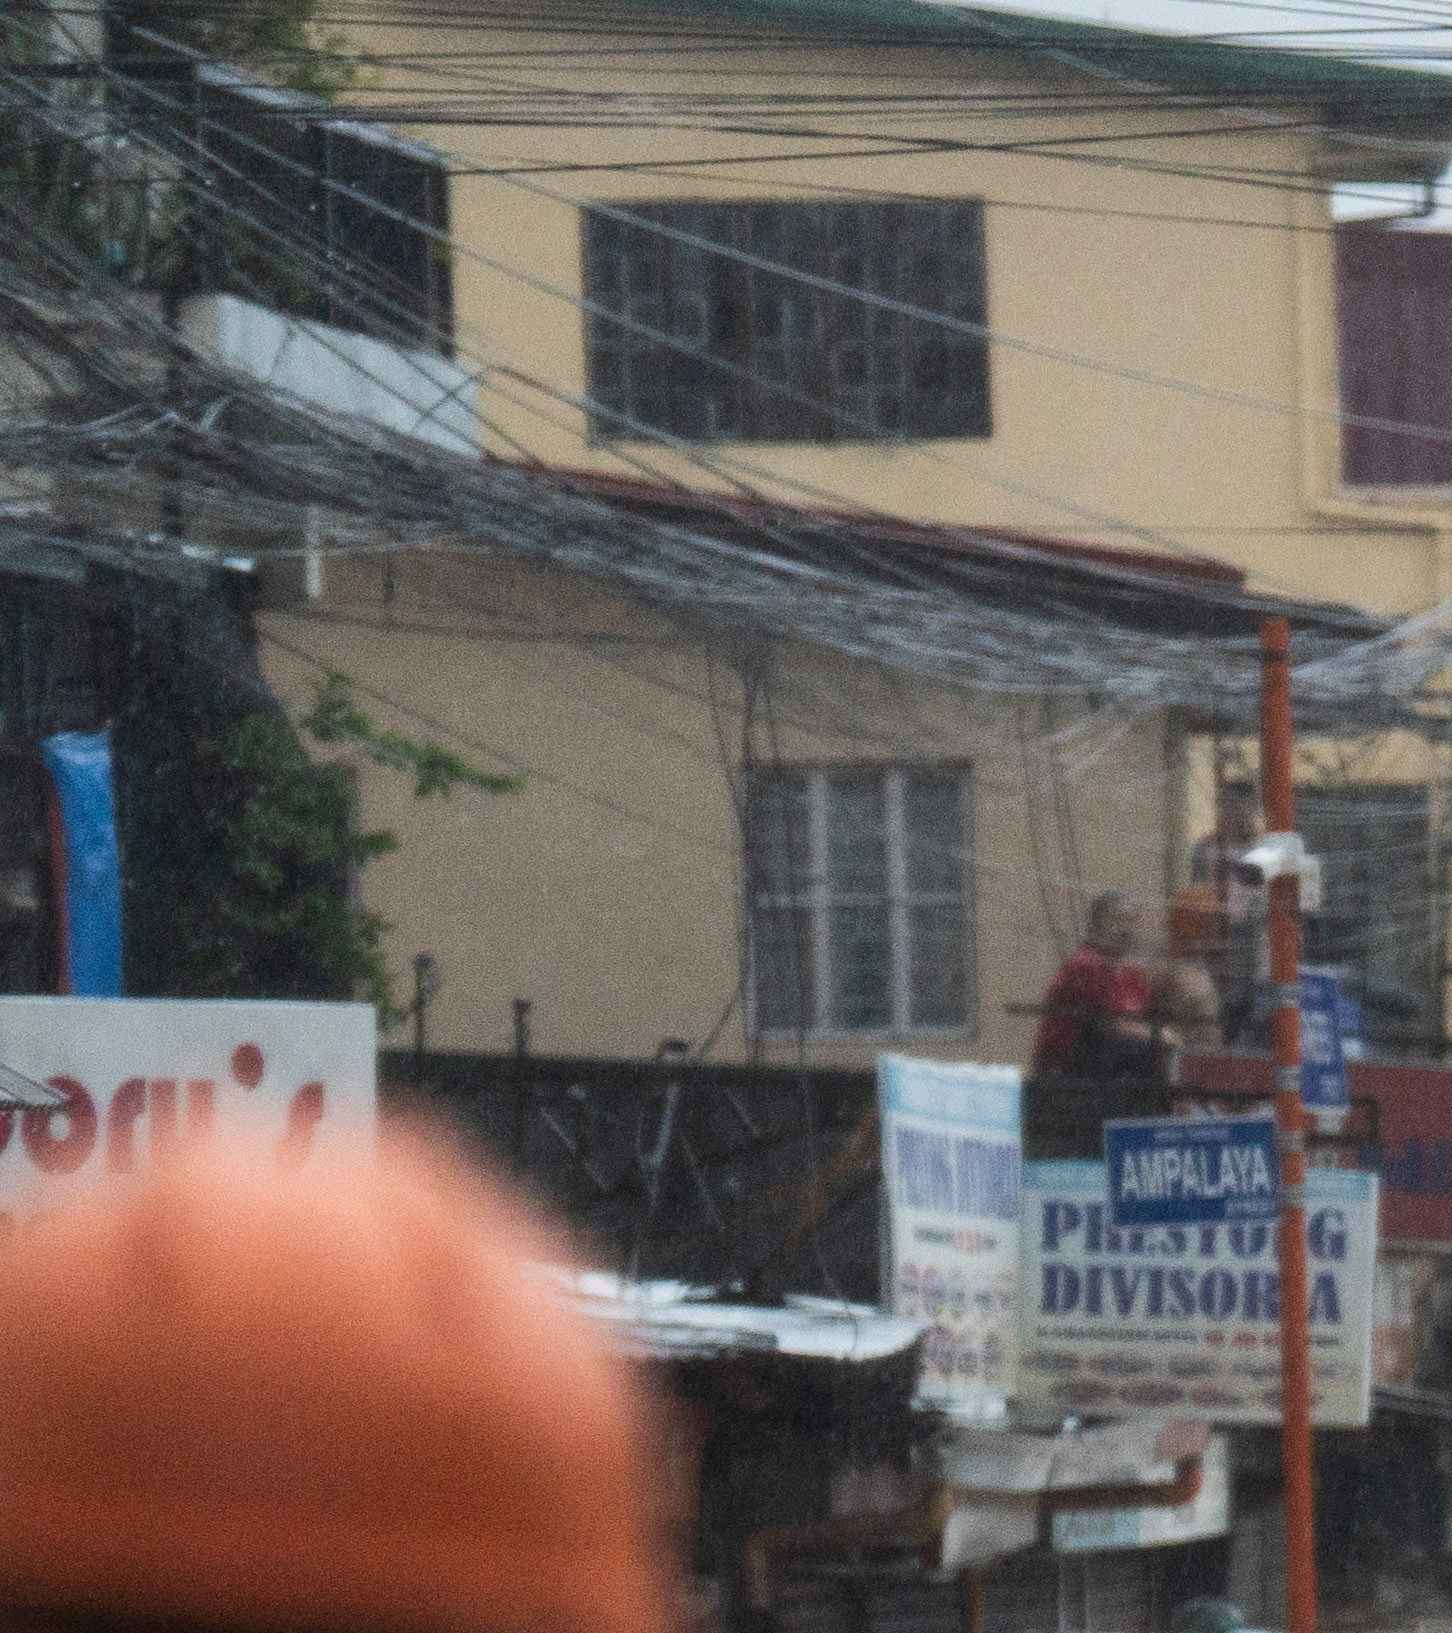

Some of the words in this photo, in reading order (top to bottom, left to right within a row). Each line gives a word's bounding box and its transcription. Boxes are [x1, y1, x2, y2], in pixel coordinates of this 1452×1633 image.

[1120, 1145, 1272, 1201] AMPALAYA
[1041, 1199, 1347, 1262] PRESYOG
[1041, 1262, 1342, 1325] DIVISORA
